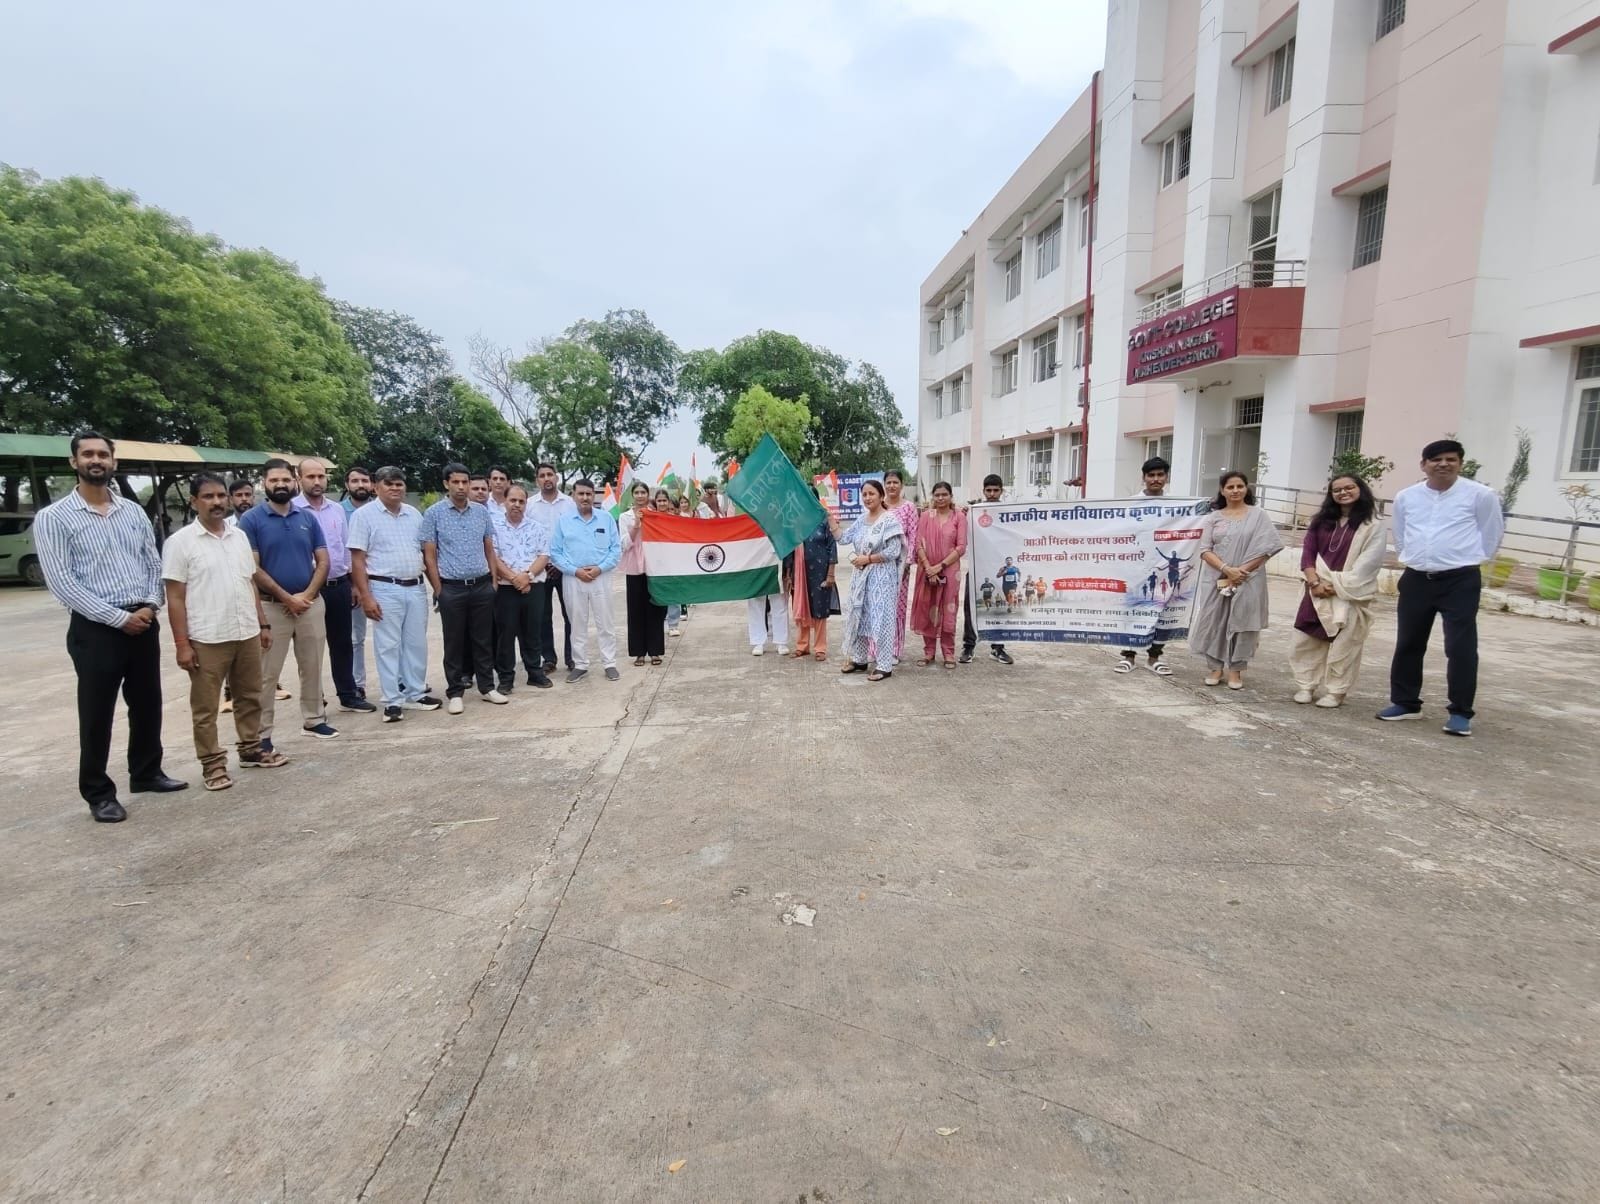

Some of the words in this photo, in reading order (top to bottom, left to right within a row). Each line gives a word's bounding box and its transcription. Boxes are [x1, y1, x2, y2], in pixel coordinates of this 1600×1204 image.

[1163, 295, 1236, 338] COLLEGE
[999, 507, 1048, 523] राजकीय
[1050, 505, 1127, 521] महाविद्यालय
[1128, 505, 1163, 522] कृष्ण
[1164, 505, 1195, 517] नगर
[1023, 536, 1047, 547] आओ
[1049, 535, 1085, 546] मिलकर
[1087, 536, 1110, 545] शपथ
[1017, 551, 1053, 563] हरियाणा
[1054, 551, 1068, 561] को
[1070, 552, 1090, 561] नशा
[1092, 552, 1116, 564] मुक्त
